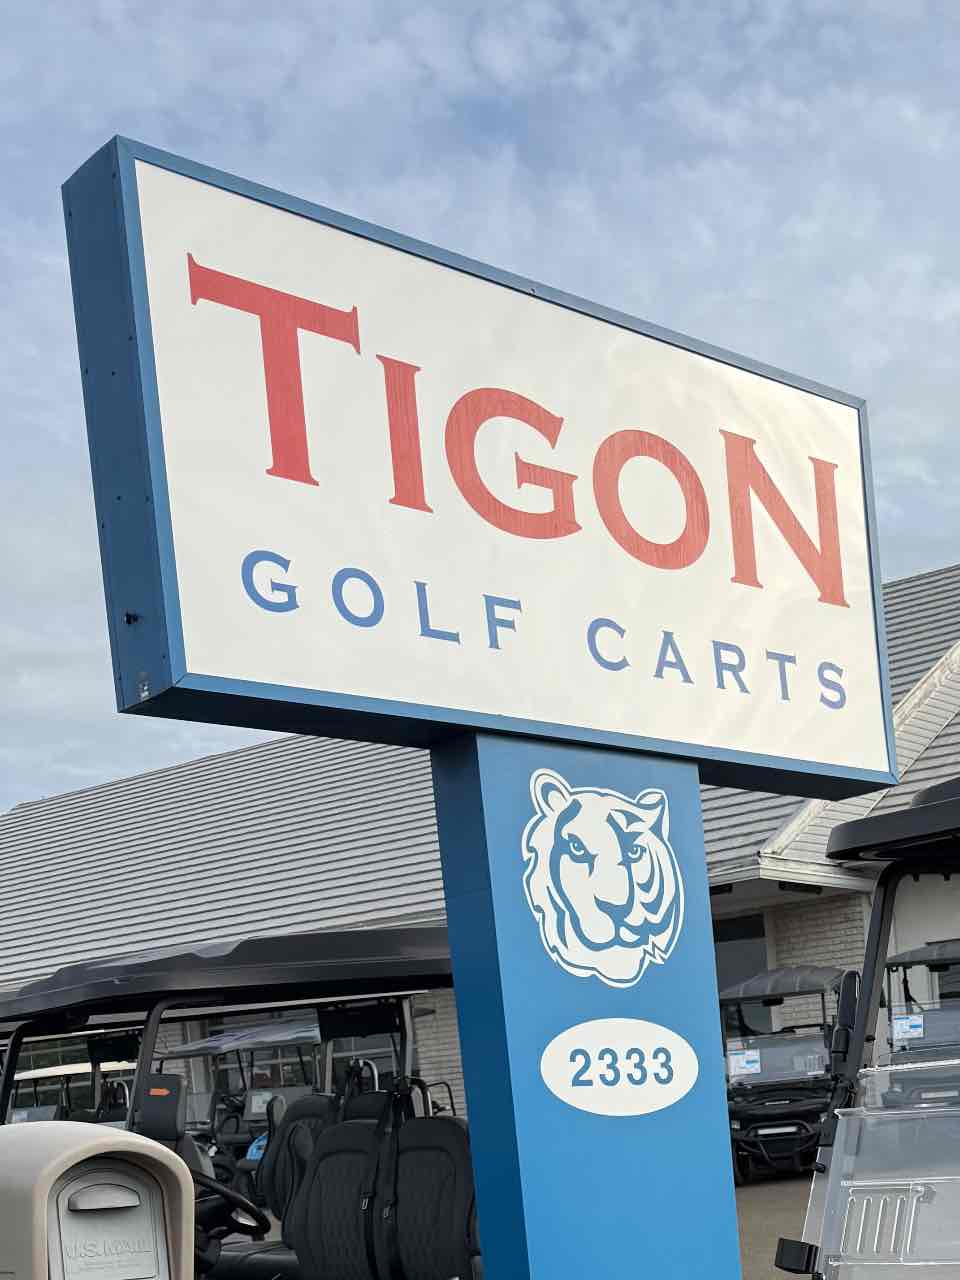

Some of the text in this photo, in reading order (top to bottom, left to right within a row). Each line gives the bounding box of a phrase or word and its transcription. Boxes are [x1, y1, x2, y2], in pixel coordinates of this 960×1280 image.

[186, 252, 852, 608] TIGON
[241, 550, 848, 710] GOLF CARTS
[569, 1047, 674, 1087] 2333
